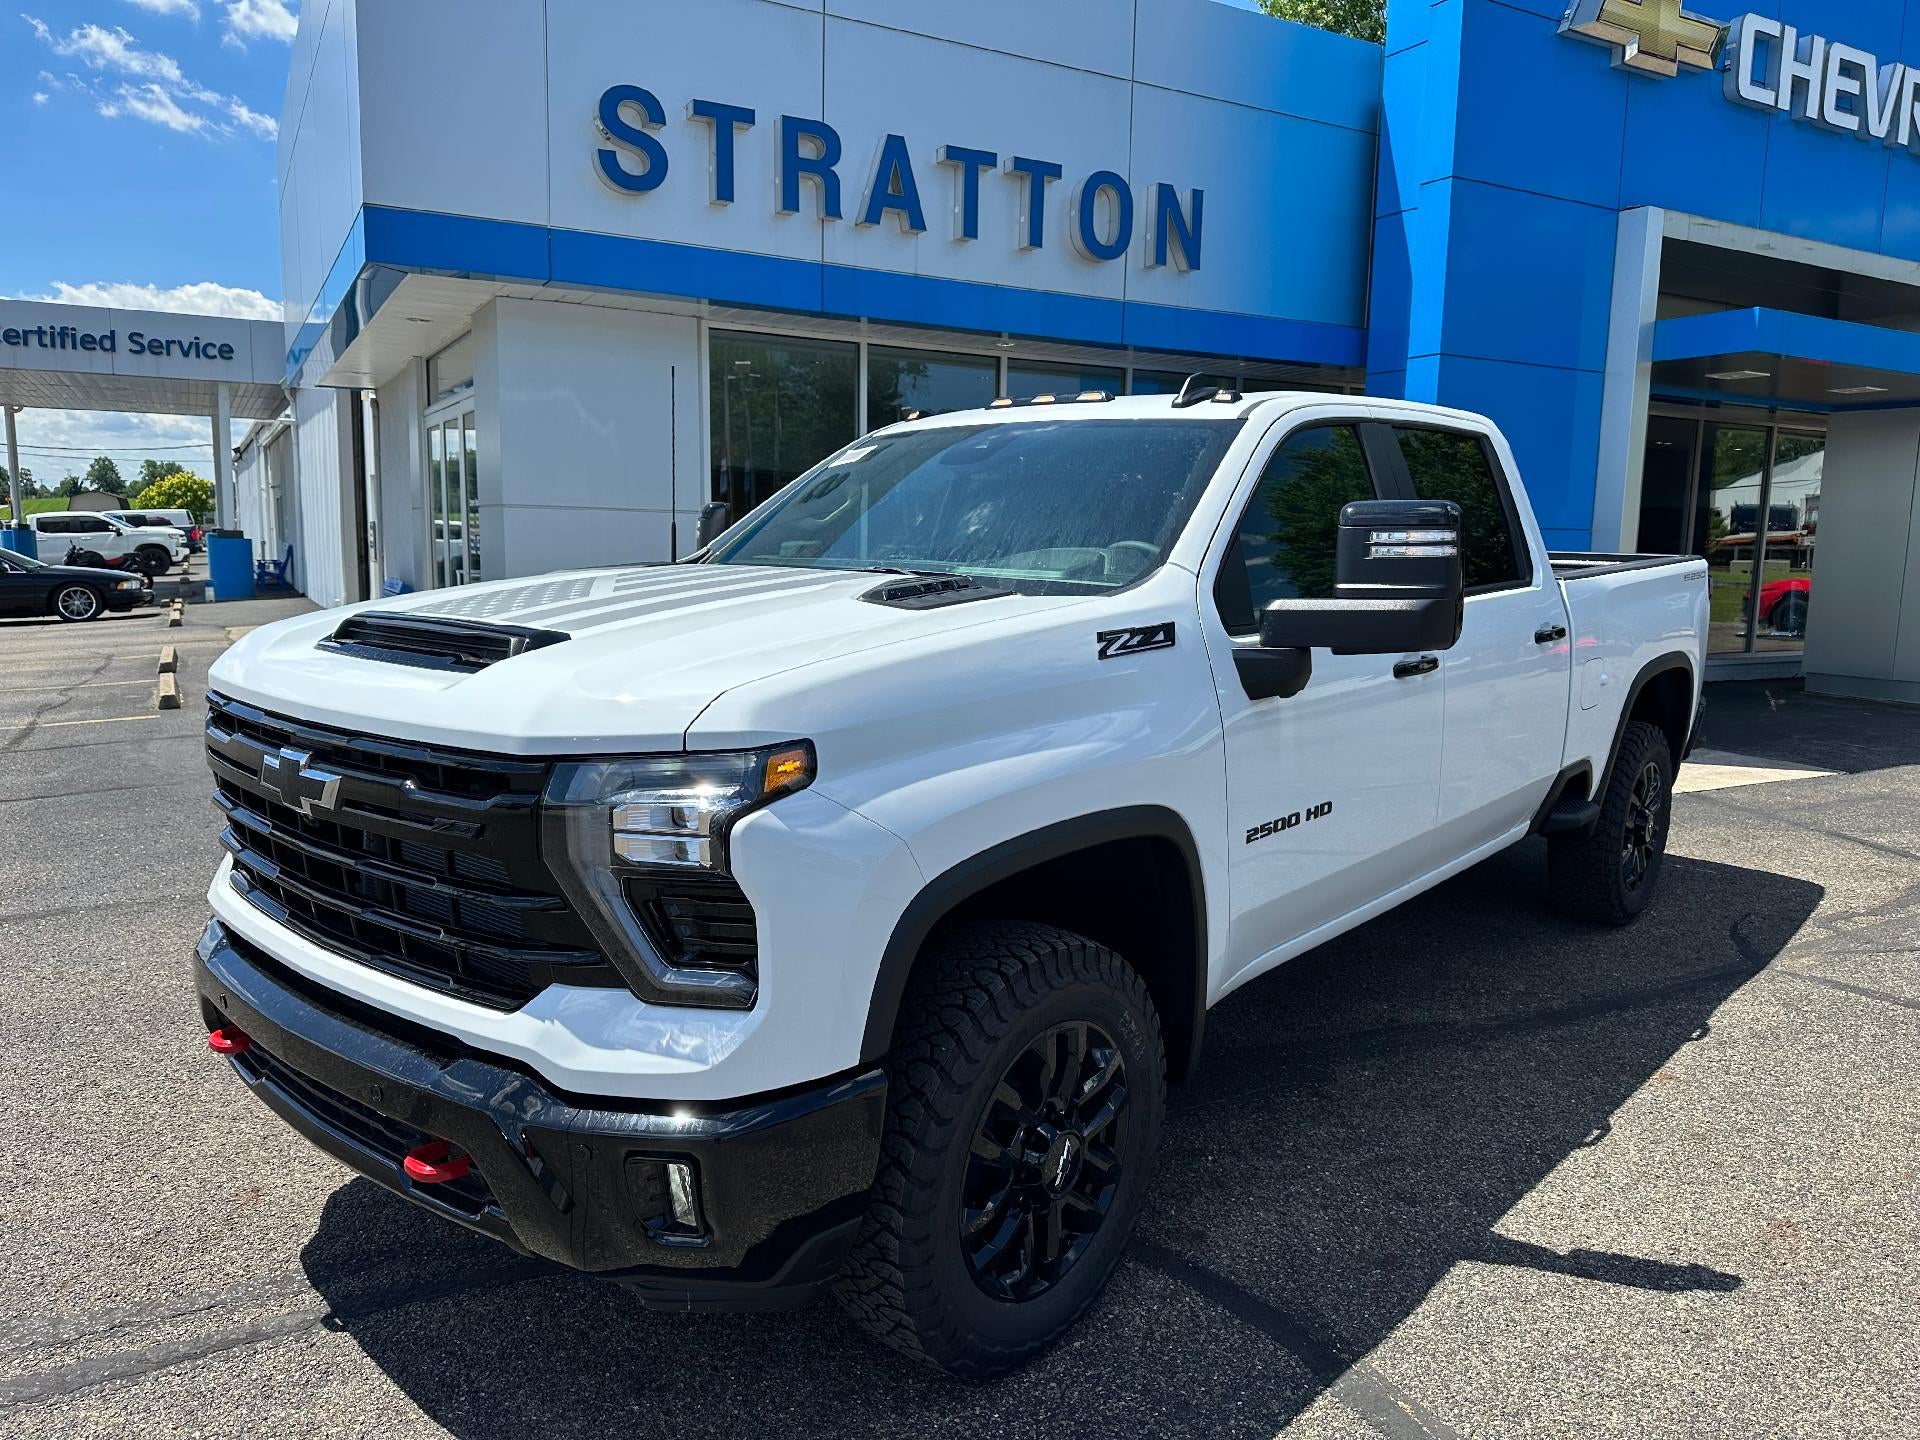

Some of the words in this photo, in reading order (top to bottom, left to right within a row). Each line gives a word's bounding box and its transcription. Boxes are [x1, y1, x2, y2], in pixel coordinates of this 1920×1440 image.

[593, 83, 1205, 273] STRATTON
[0, 324, 117, 354] ertified
[127, 330, 235, 361] Service
[1097, 620, 1176, 660] Z71
[1245, 811, 1301, 844] 2500
[1305, 800, 1333, 822] HD
